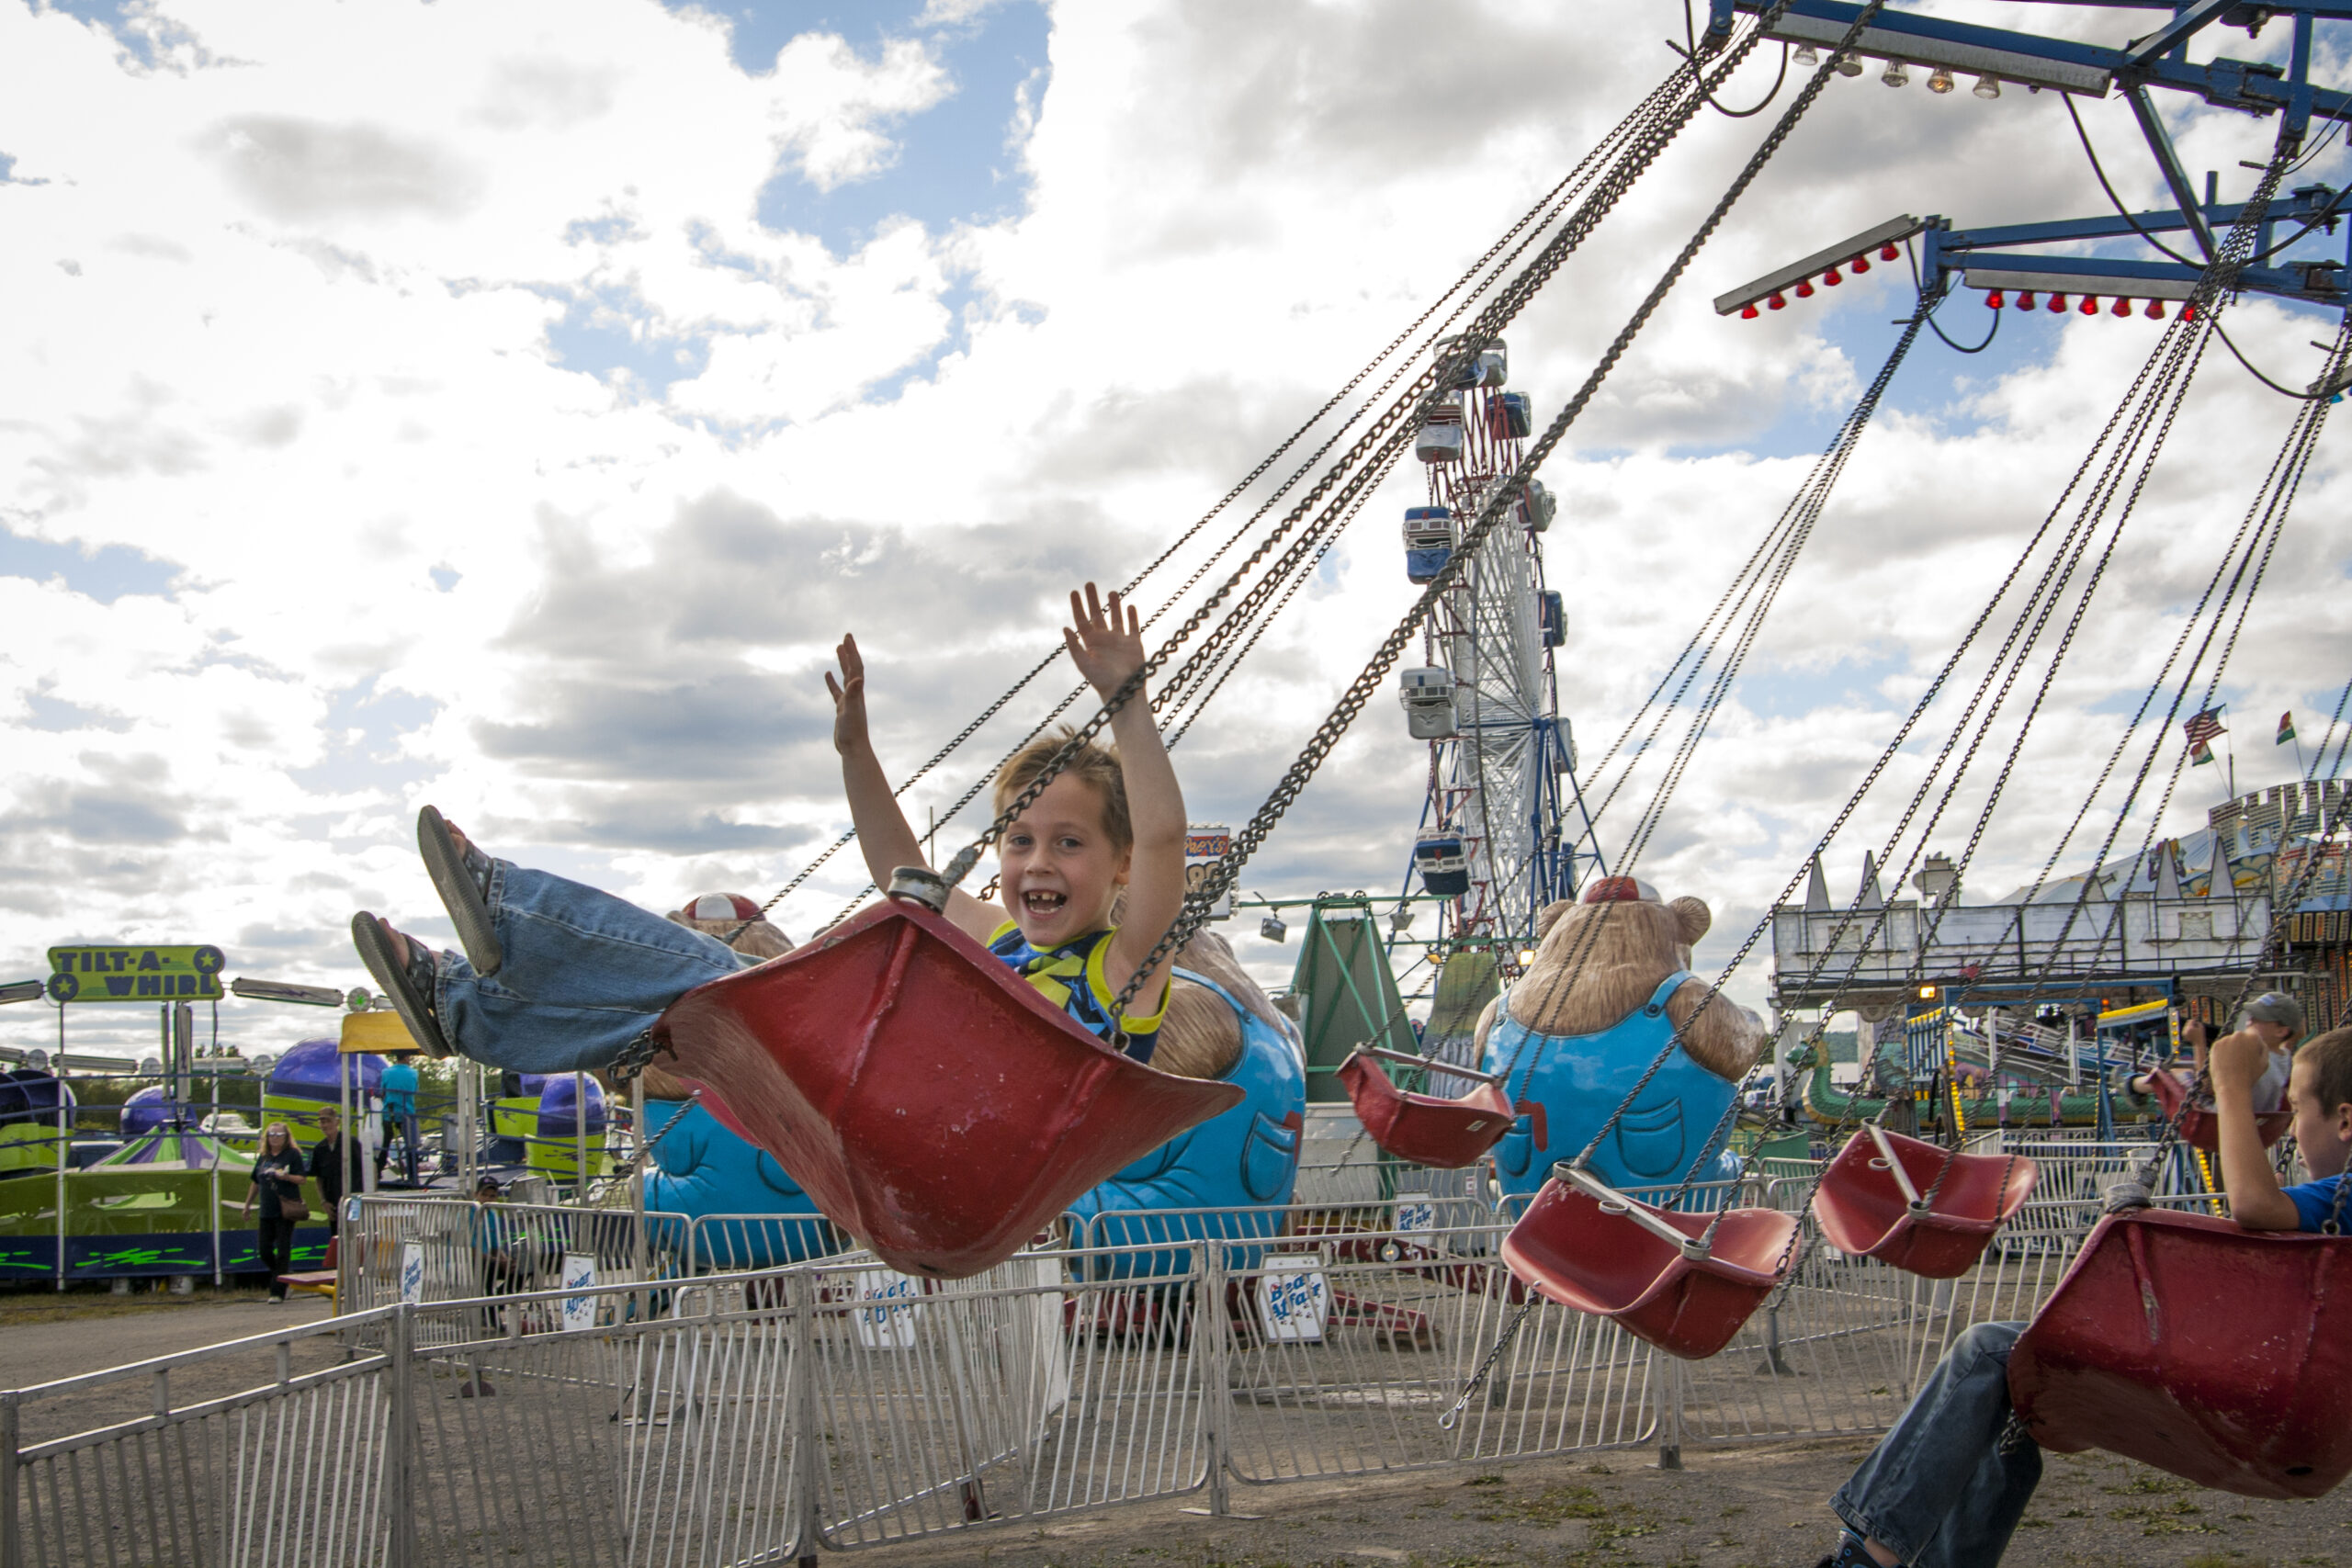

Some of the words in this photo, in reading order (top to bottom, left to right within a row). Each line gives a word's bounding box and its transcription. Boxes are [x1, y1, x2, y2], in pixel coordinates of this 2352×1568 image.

[57, 951, 170, 973] TILT-A-
[104, 975, 215, 996] WHIRL
[1269, 1283, 1322, 1320] Affar
